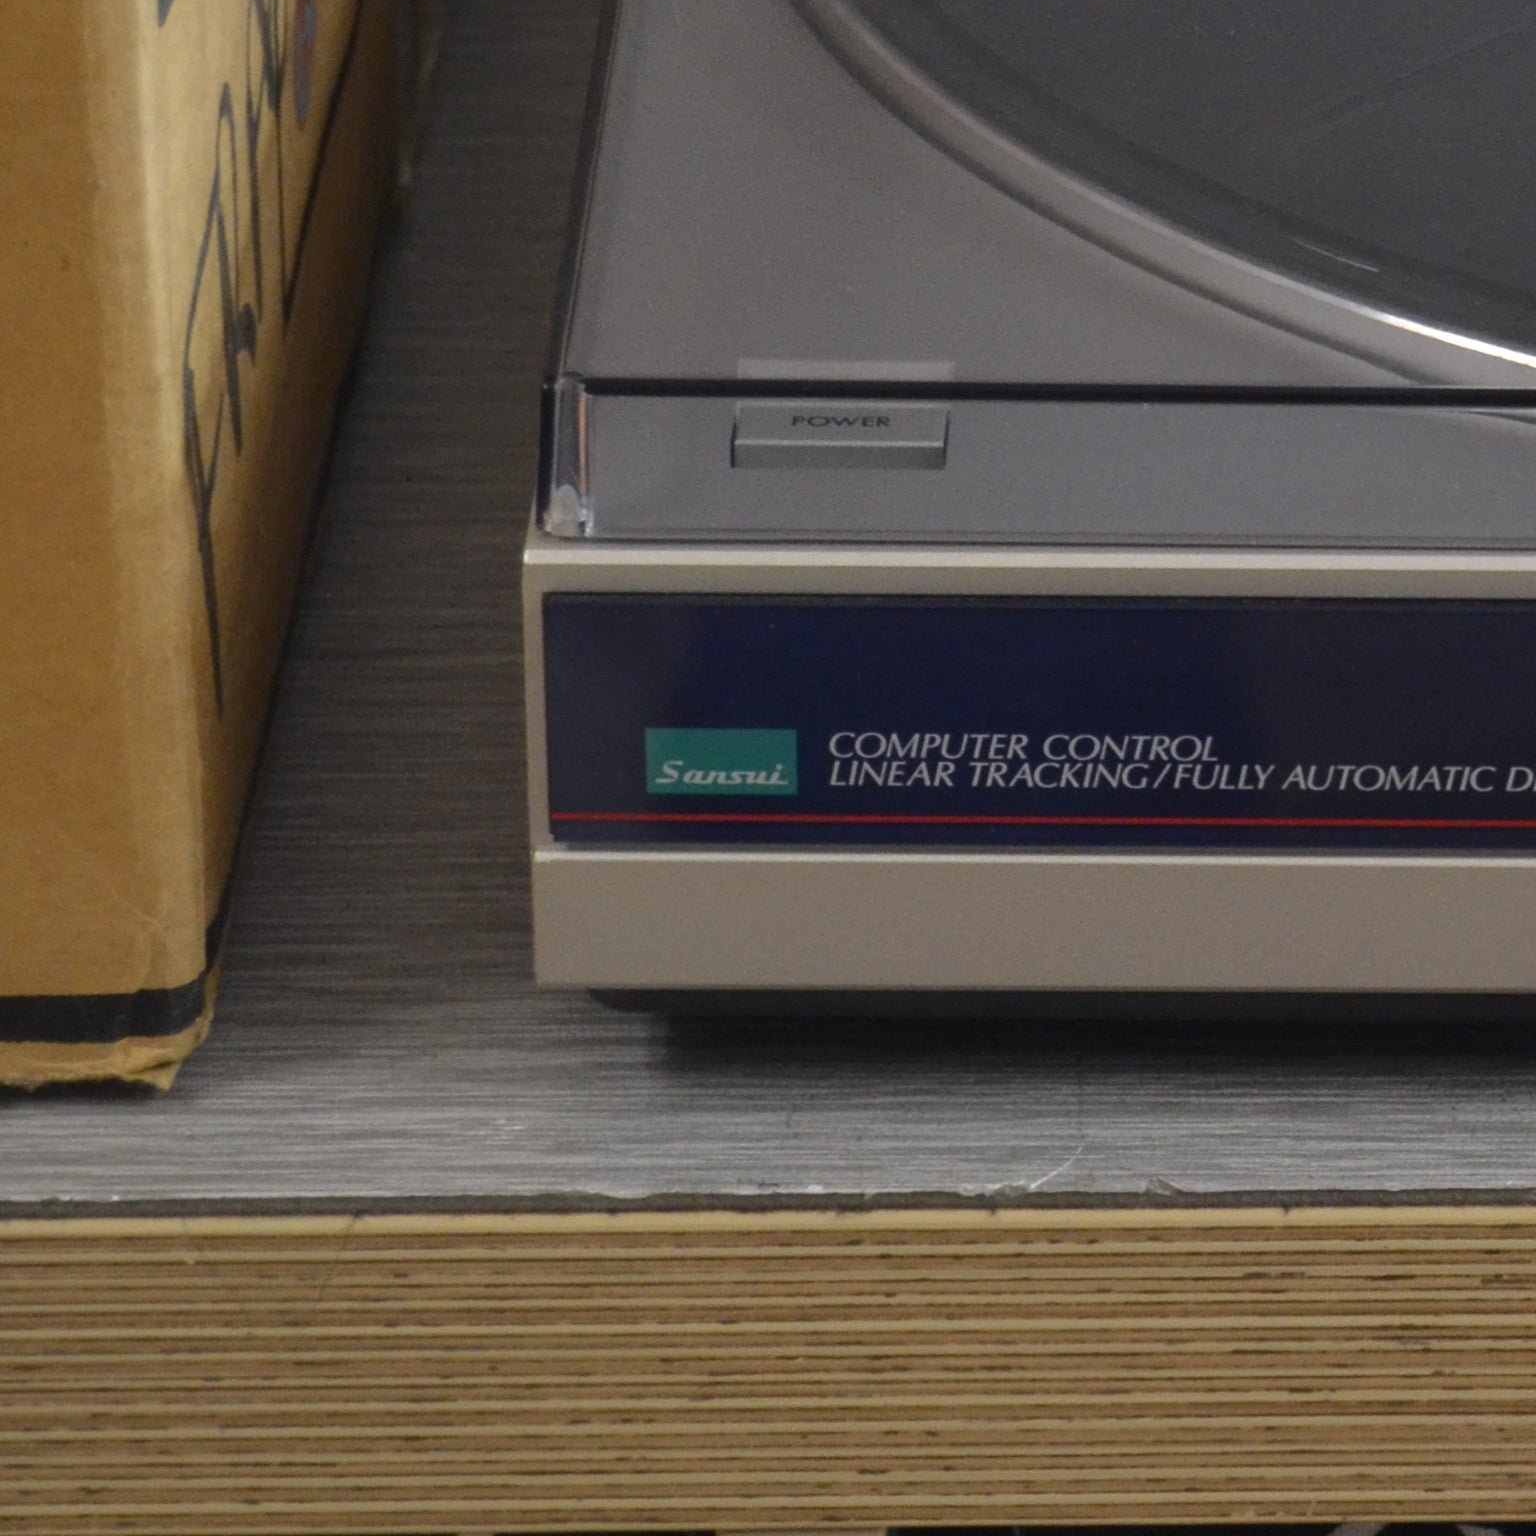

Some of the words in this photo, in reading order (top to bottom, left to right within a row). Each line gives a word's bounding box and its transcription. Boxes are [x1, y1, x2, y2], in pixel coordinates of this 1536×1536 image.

[791, 415, 891, 428] POWER
[828, 731, 1028, 761] COMPUTER
[1043, 734, 1218, 763] CONTROL
[655, 760, 790, 786] Sansui
[828, 761, 955, 787] LINEAR
[969, 762, 1275, 790] TRACKING/FULLY
[1282, 765, 1496, 793] AUTOMATIC
